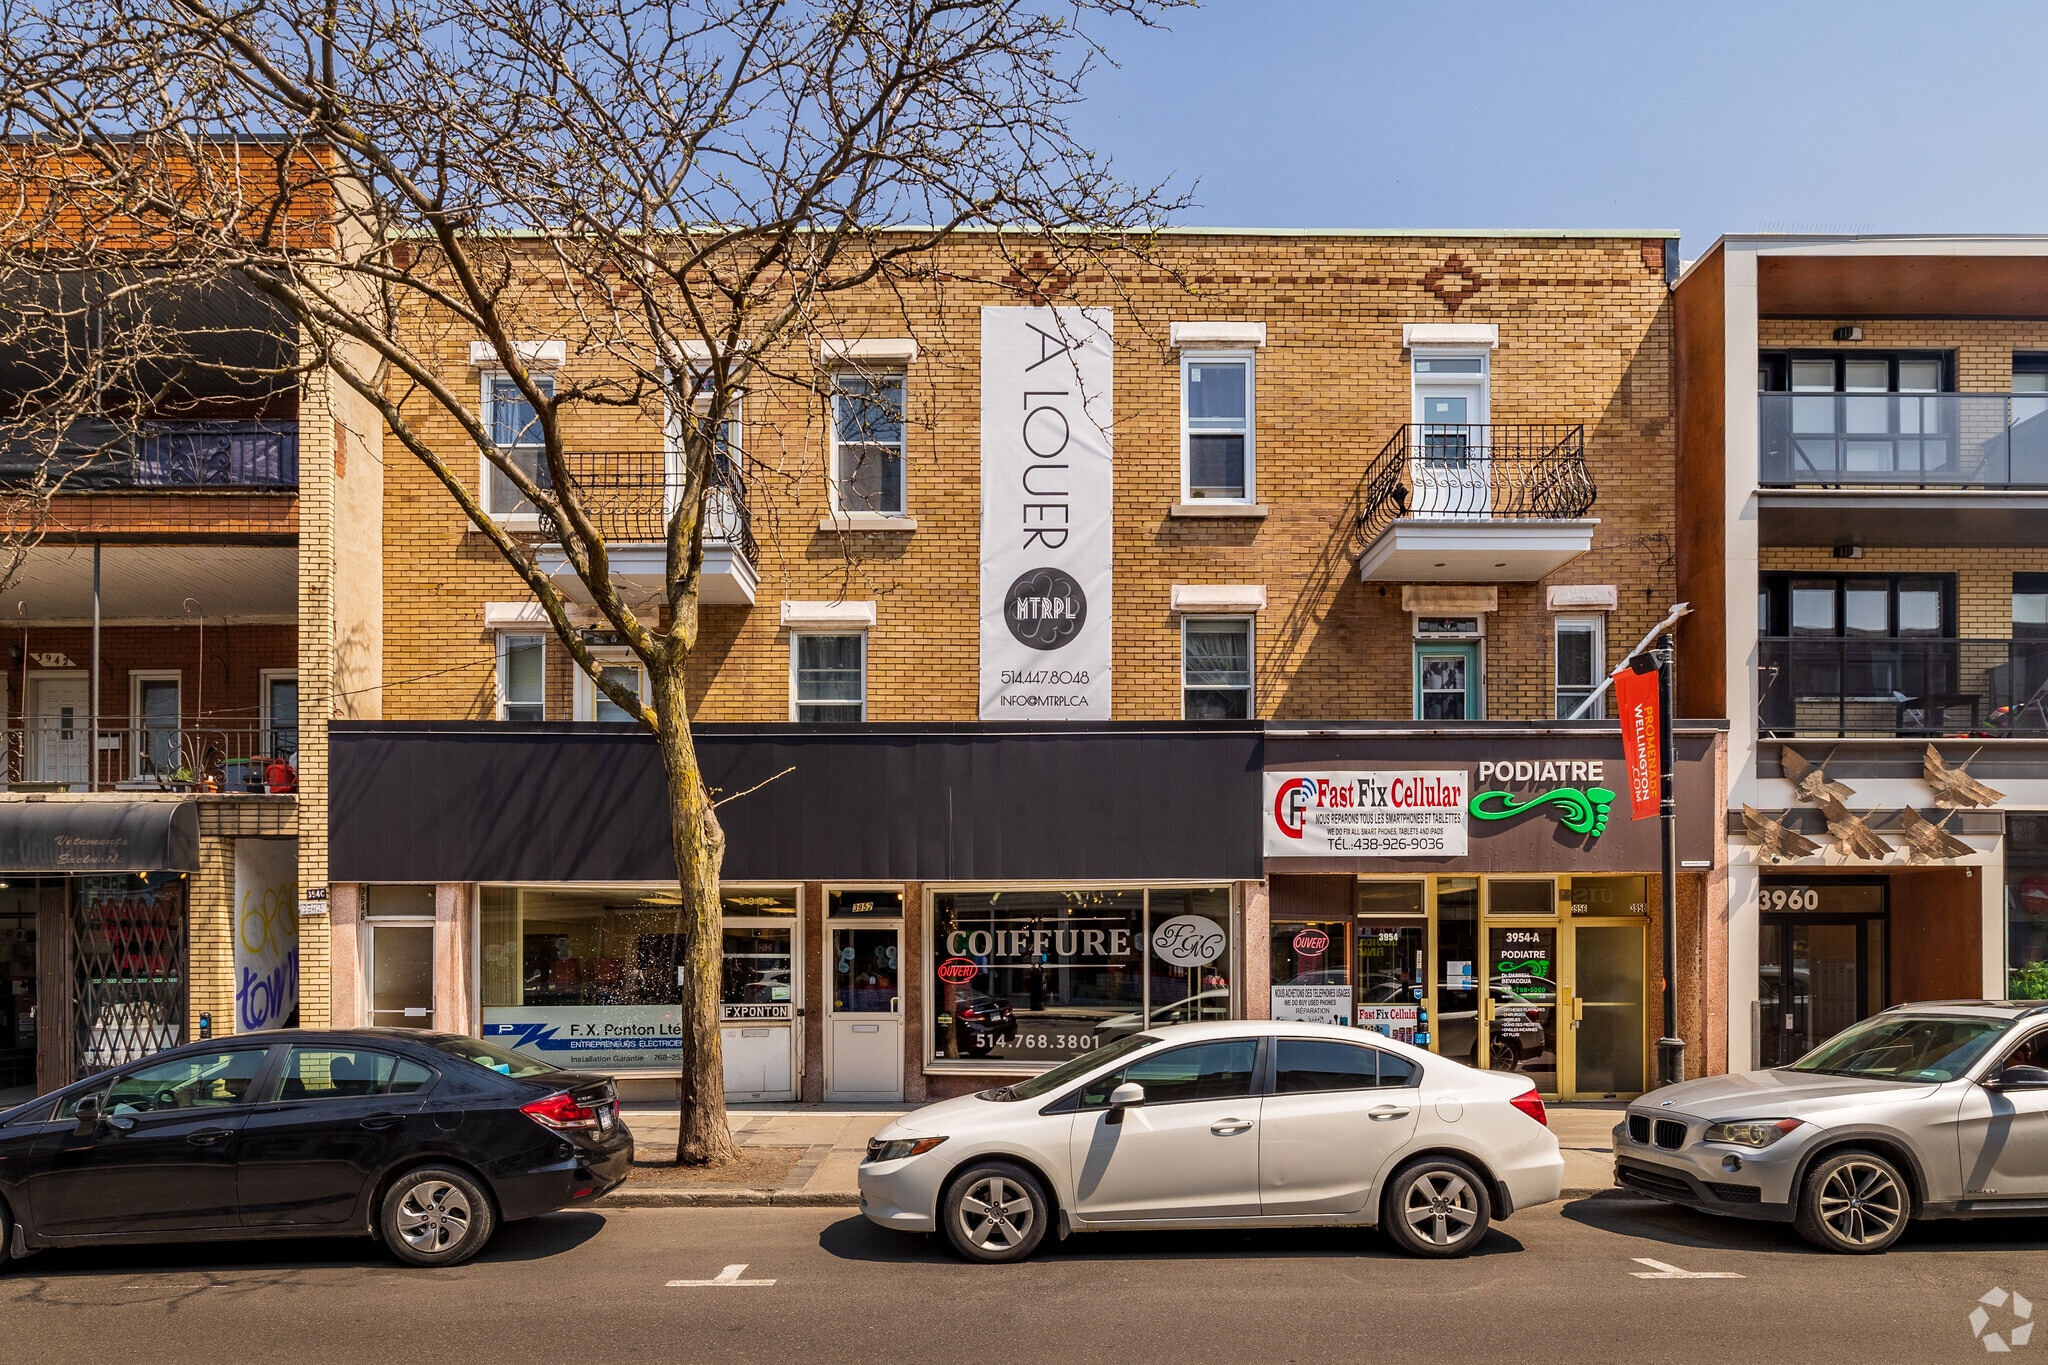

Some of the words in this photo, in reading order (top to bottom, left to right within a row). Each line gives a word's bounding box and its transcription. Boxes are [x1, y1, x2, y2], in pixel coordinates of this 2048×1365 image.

[1023, 391, 1069, 550] LOUER
[1017, 597, 1076, 619] MTRPL
[36, 652, 69, 666] 3942
[1001, 671, 1090, 685] 514.447.8048
[1634, 703, 1650, 801] WELLINGTON
[1644, 706, 1657, 798] PROMENADE
[1479, 761, 1604, 782] PODIATRE
[1631, 765, 1643, 802] .COM
[1316, 779, 1354, 809] Fast
[1357, 778, 1388, 808] Fix
[1391, 777, 1461, 809] Cellular
[1315, 813, 1330, 825] NOUS
[1360, 813, 1373, 825] TOUS
[1374, 813, 1385, 825] LES
[1385, 813, 1424, 825] SMARTPHONES
[1425, 813, 1432, 825] ET
[1433, 813, 1461, 825] TABLETTES
[1327, 828, 1334, 836] WE
[1335, 828, 1343, 836] DO
[1343, 828, 1351, 836] FIX
[1352, 828, 1360, 836] ALL
[1361, 828, 1377, 836] SMART
[1398, 828, 1418, 836] TABLETS
[1419, 828, 1429, 836] AND
[853, 902, 873, 912] 3952
[1759, 889, 1819, 911] 3960
[946, 929, 1131, 957] COIFFURE
[1295, 937, 1327, 949] OUVERT
[1379, 933, 1398, 941] 3954
[1506, 932, 1540, 943] 3954-A
[1501, 950, 1546, 959] PODIATRE
[940, 965, 974, 977] OUVERT
[1275, 988, 1285, 998] NOUS
[1286, 988, 1304, 998] ACHETONS
[1296, 1006, 1330, 1014] RÉPARATION
[1359, 1009, 1375, 1020] Fast
[1376, 1009, 1389, 1020] Fix
[570, 1024, 583, 1036] F.
[586, 1024, 599, 1035] X.
[604, 1023, 654, 1035] Ponton
[660, 1022, 682, 1035] Lté
[976, 1033, 1100, 1050] 514.768.3801
[570, 1055, 611, 1063] Installation
[654, 1053, 685, 1061] 768-253
